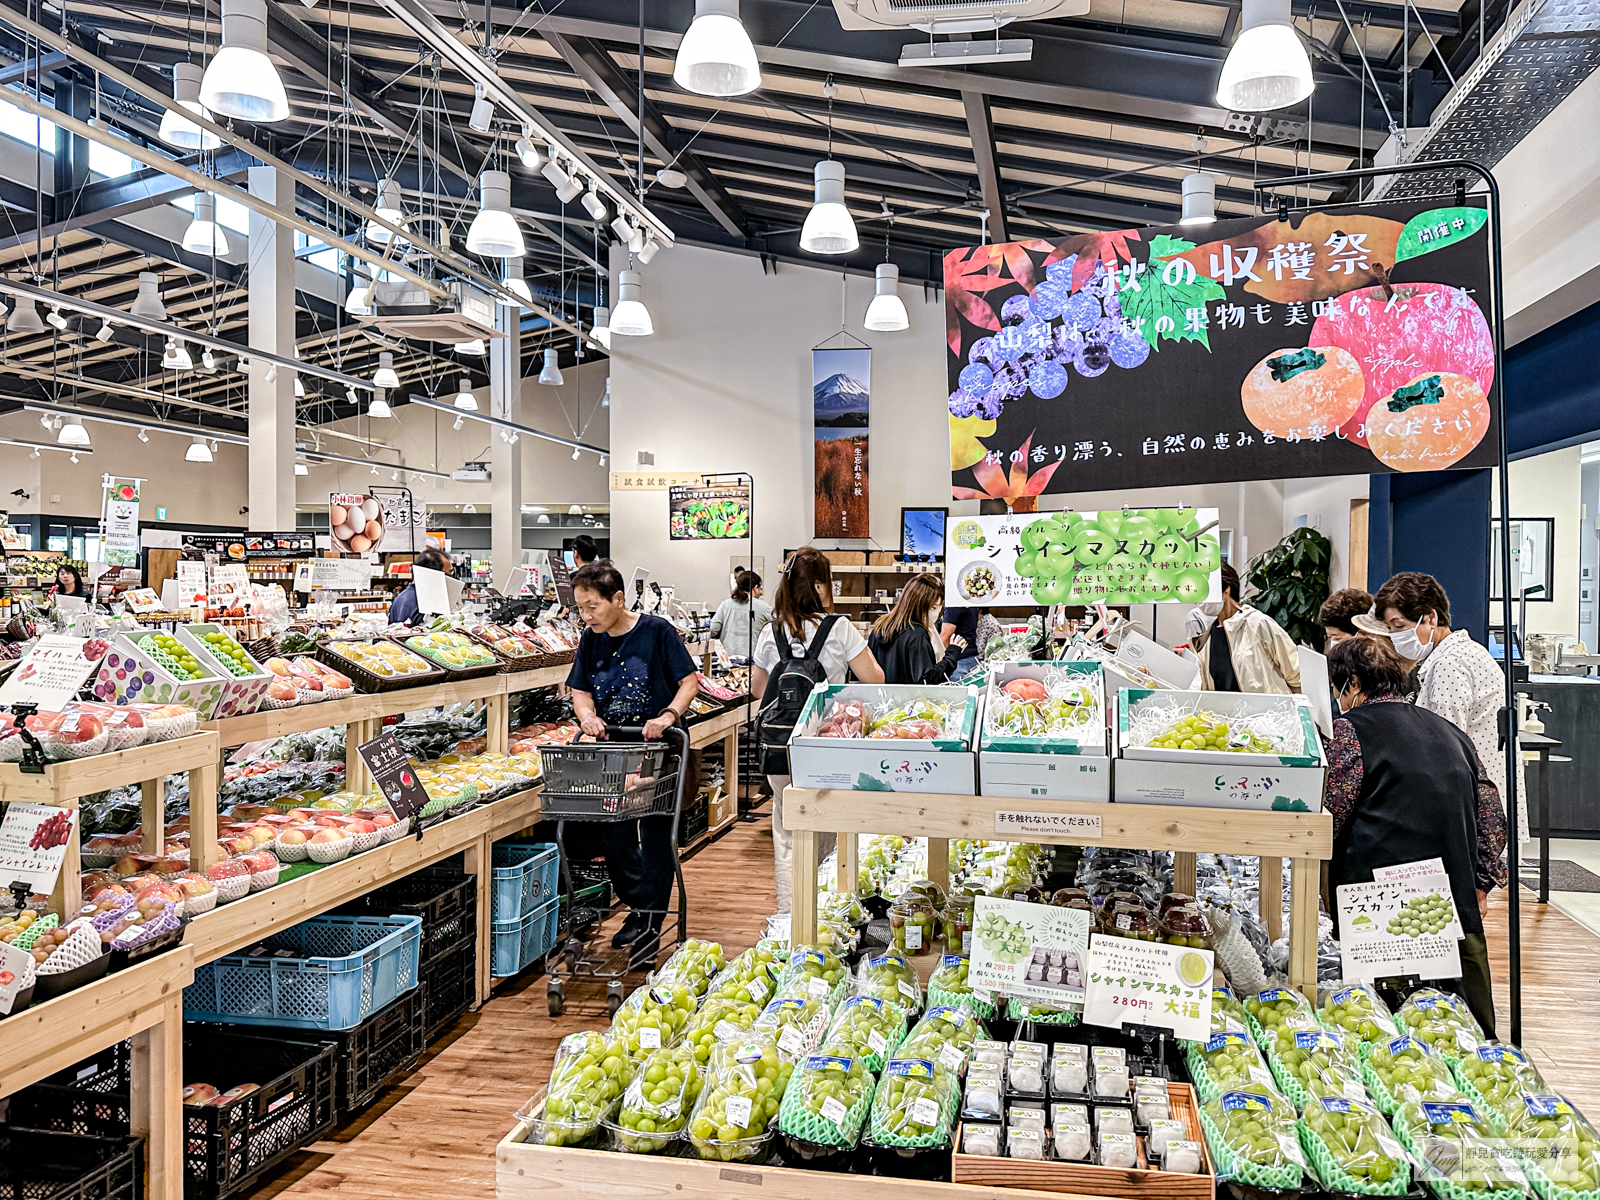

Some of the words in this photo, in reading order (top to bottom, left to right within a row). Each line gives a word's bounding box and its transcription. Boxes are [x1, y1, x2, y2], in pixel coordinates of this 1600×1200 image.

[1417, 217, 1465, 244] 開催中
[1103, 233, 1372, 296] 秋の収穫祭
[1363, 353, 1423, 374] apple
[963, 376, 1046, 400] grapes
[1380, 450, 1414, 461] kaki
[1418, 447, 1459, 461] fruit
[853, 442, 863, 497] 一生忘れない秋
[624, 477, 703, 487] 試食試飲コーナ
[383, 509, 425, 526] たまご
[957, 525, 978, 535] 山梨
[998, 524, 1070, 535] 高級フルーツ
[987, 536, 1208, 559] シャインマスカット
[33, 649, 82, 661] マイハート
[879, 758, 938, 774] ぶどう
[1214, 774, 1280, 791] ぶどう
[998, 813, 1095, 826] 手を触れないでください
[1021, 825, 1039, 833] Please
[1384, 864, 1432, 876] 箱に入っていない
[1349, 891, 1401, 903] シャイン
[1343, 900, 1408, 914] マスカット
[992, 918, 1035, 930] シャイン
[985, 930, 1039, 944] マスカット
[1000, 942, 1023, 954] 大福
[1094, 940, 1168, 957] 山梨県産マスカット使用
[1090, 972, 1208, 1000] シャインマスカット
[1112, 995, 1148, 1010] 280円
[1163, 999, 1201, 1019] 大福
